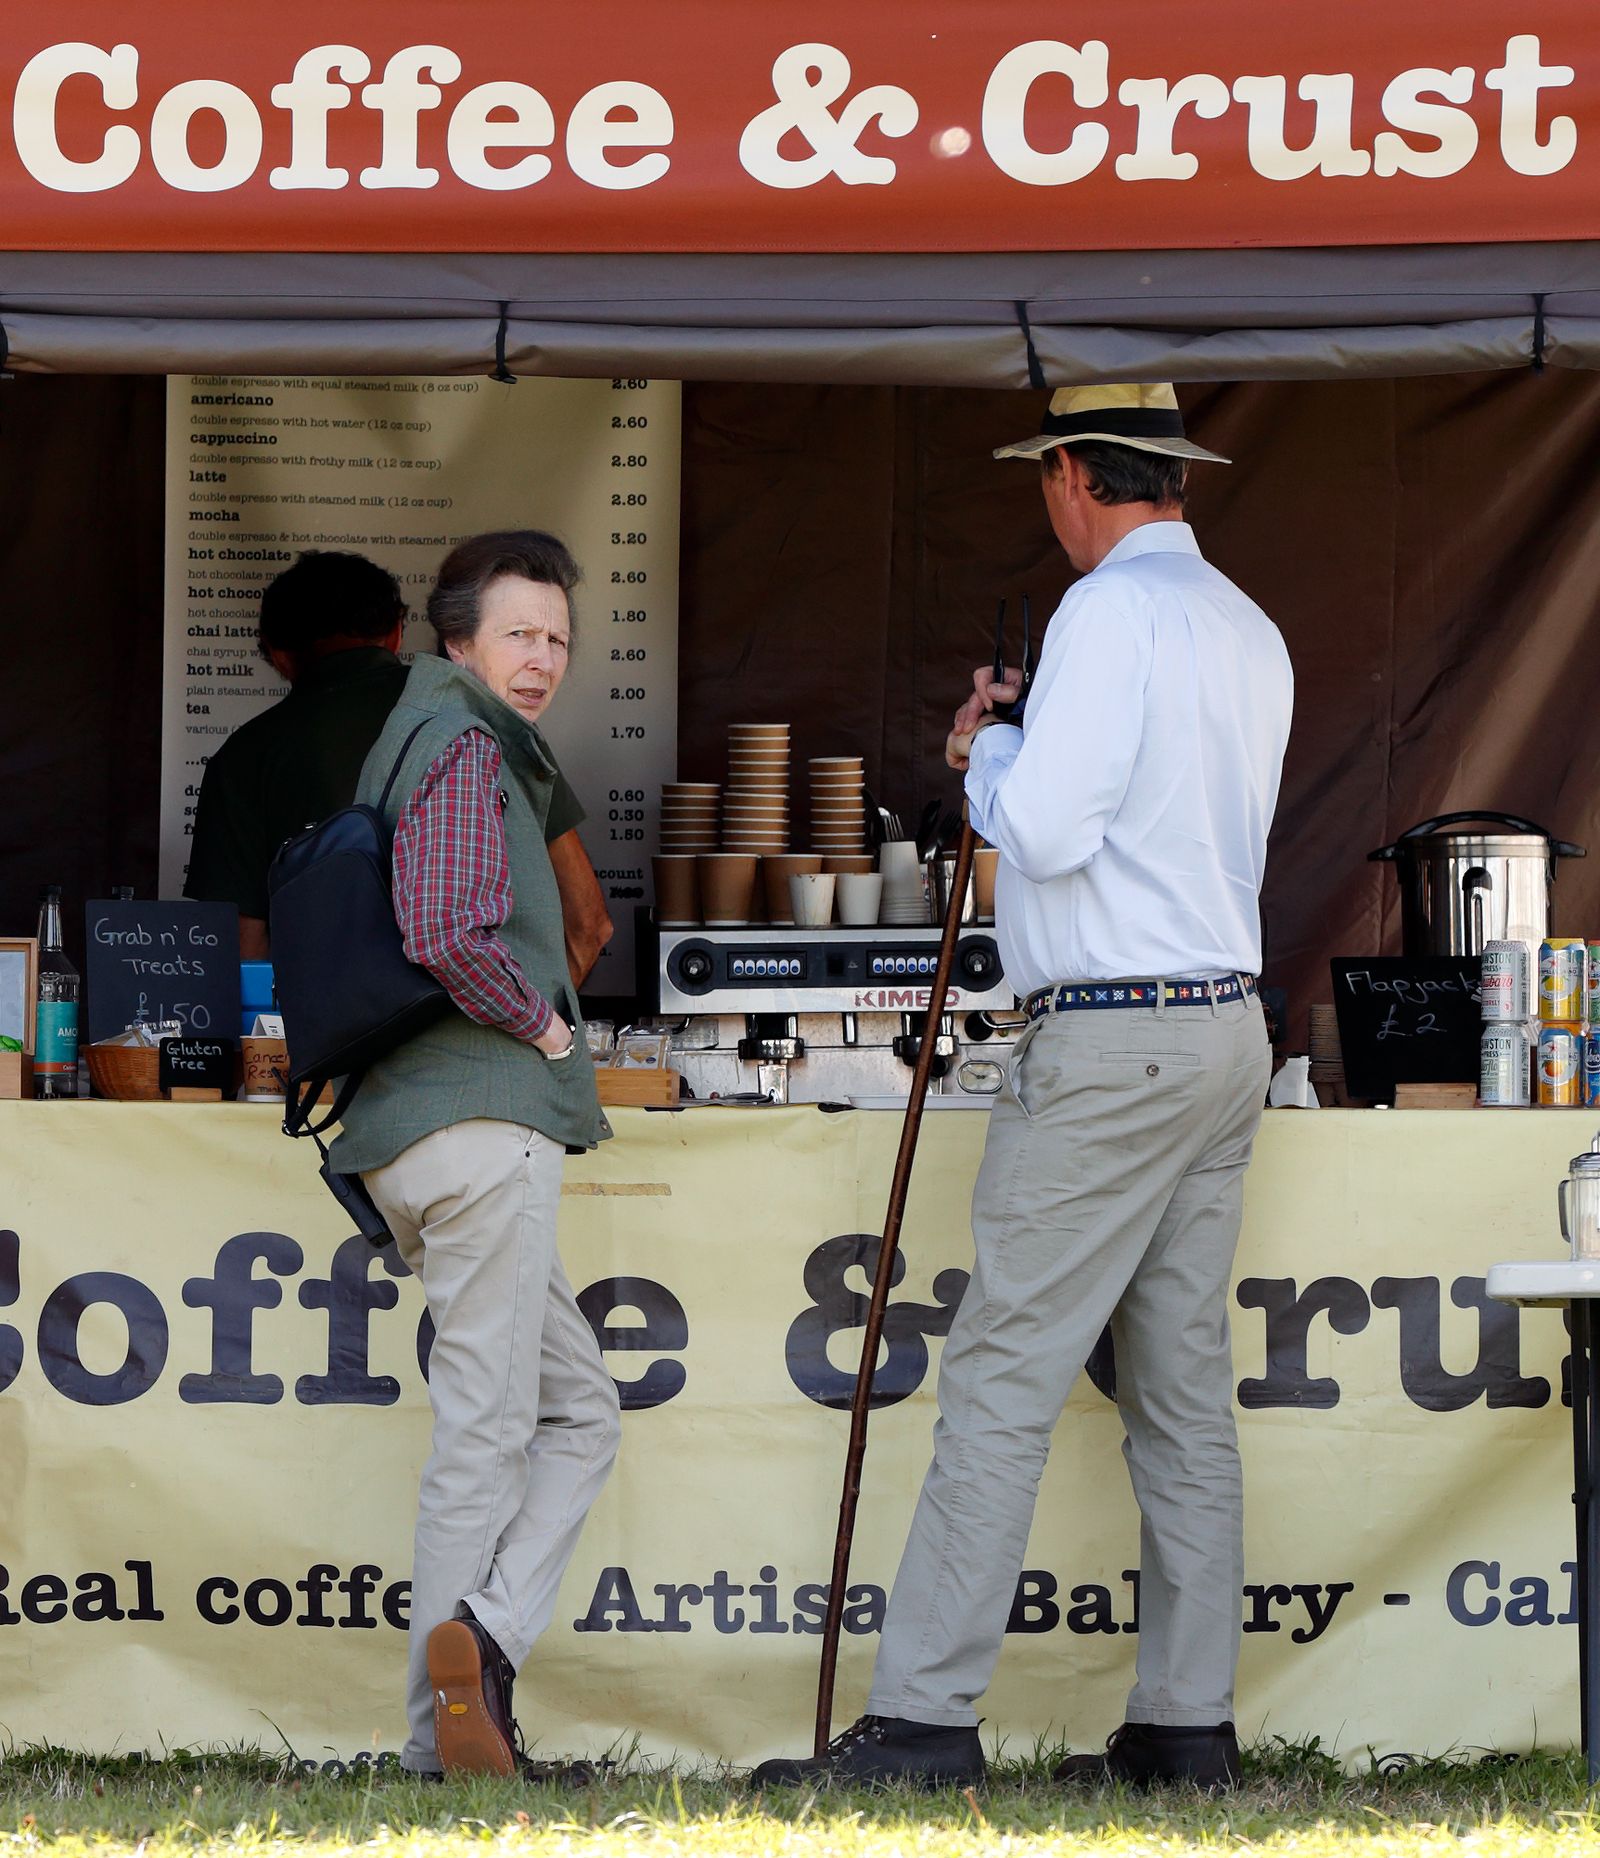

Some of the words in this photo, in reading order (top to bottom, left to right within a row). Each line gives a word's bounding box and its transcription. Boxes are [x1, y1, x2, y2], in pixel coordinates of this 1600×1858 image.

[13, 42, 674, 193] Coffee
[739, 42, 919, 189] &
[981, 34, 1577, 186] Crust
[191, 376, 228, 386] double
[231, 378, 280, 389] espresso
[284, 378, 308, 389] with
[311, 380, 341, 391] equal
[344, 381, 390, 391] steamed
[393, 383, 418, 392] milk
[421, 382, 434, 393] (8
[437, 384, 450, 392] oz
[453, 382, 479, 393] cup)
[612, 378, 648, 390] 2.60
[190, 393, 274, 406] americano
[190, 415, 227, 425] double
[229, 416, 279, 428] espresso
[282, 416, 307, 427] with
[310, 417, 329, 428] hot
[332, 419, 365, 429] water
[367, 419, 388, 431] (12
[390, 422, 404, 431] oz
[405, 421, 432, 433] cup)
[611, 416, 648, 429] 2.60
[190, 432, 278, 446] cappuccino
[189, 454, 227, 464] double
[229, 455, 279, 466] espresso
[281, 456, 306, 465] with
[309, 456, 345, 469] frothy
[348, 457, 373, 468] milk
[376, 457, 397, 470] (12
[399, 460, 413, 469] oz
[415, 459, 442, 472] cup)
[611, 455, 648, 468] 2.80
[189, 470, 227, 483] latte
[189, 492, 227, 503] double
[229, 494, 278, 506] espresso
[280, 494, 306, 504] with
[308, 495, 356, 506] steamed
[359, 496, 385, 506] milk
[388, 496, 408, 509] (12
[411, 499, 424, 507] oz
[426, 497, 453, 510] cup)
[611, 494, 648, 507] 2.80
[189, 509, 241, 522] mocha
[188, 531, 226, 542] double
[228, 533, 277, 544] espresso
[279, 533, 290, 543] &
[291, 533, 312, 544] hot
[313, 534, 368, 545] chocolate
[370, 535, 396, 545] with
[398, 535, 447, 546] steamed
[611, 532, 647, 545] 3.20
[188, 547, 214, 561] hot
[218, 549, 292, 562] chocolate
[188, 569, 208, 581] hot
[209, 570, 264, 582] chocolate
[611, 571, 647, 584] 2.60
[188, 586, 214, 599] hot
[187, 608, 206, 619] hot
[612, 610, 647, 623] 1.80
[187, 625, 220, 637] chai
[186, 646, 210, 657] chai
[213, 648, 247, 659] syrup
[610, 649, 646, 662] 2.60
[186, 664, 213, 675] hot
[216, 664, 254, 676] milk
[186, 685, 214, 697] plain
[217, 686, 265, 697] steamed
[610, 688, 646, 700] 2.00
[186, 702, 210, 714] tea
[186, 725, 228, 735] various
[611, 726, 645, 739] 1.70
[608, 790, 644, 803] 0.60
[608, 809, 644, 822] 0.30
[609, 829, 644, 842] 1.50
[95, 918, 152, 947] Grab
[188, 925, 219, 946] Go
[121, 955, 205, 976] Treats
[166, 1040, 223, 1056] Gluten
[171, 1057, 206, 1071] Free
[0, 1560, 164, 1626] eal
